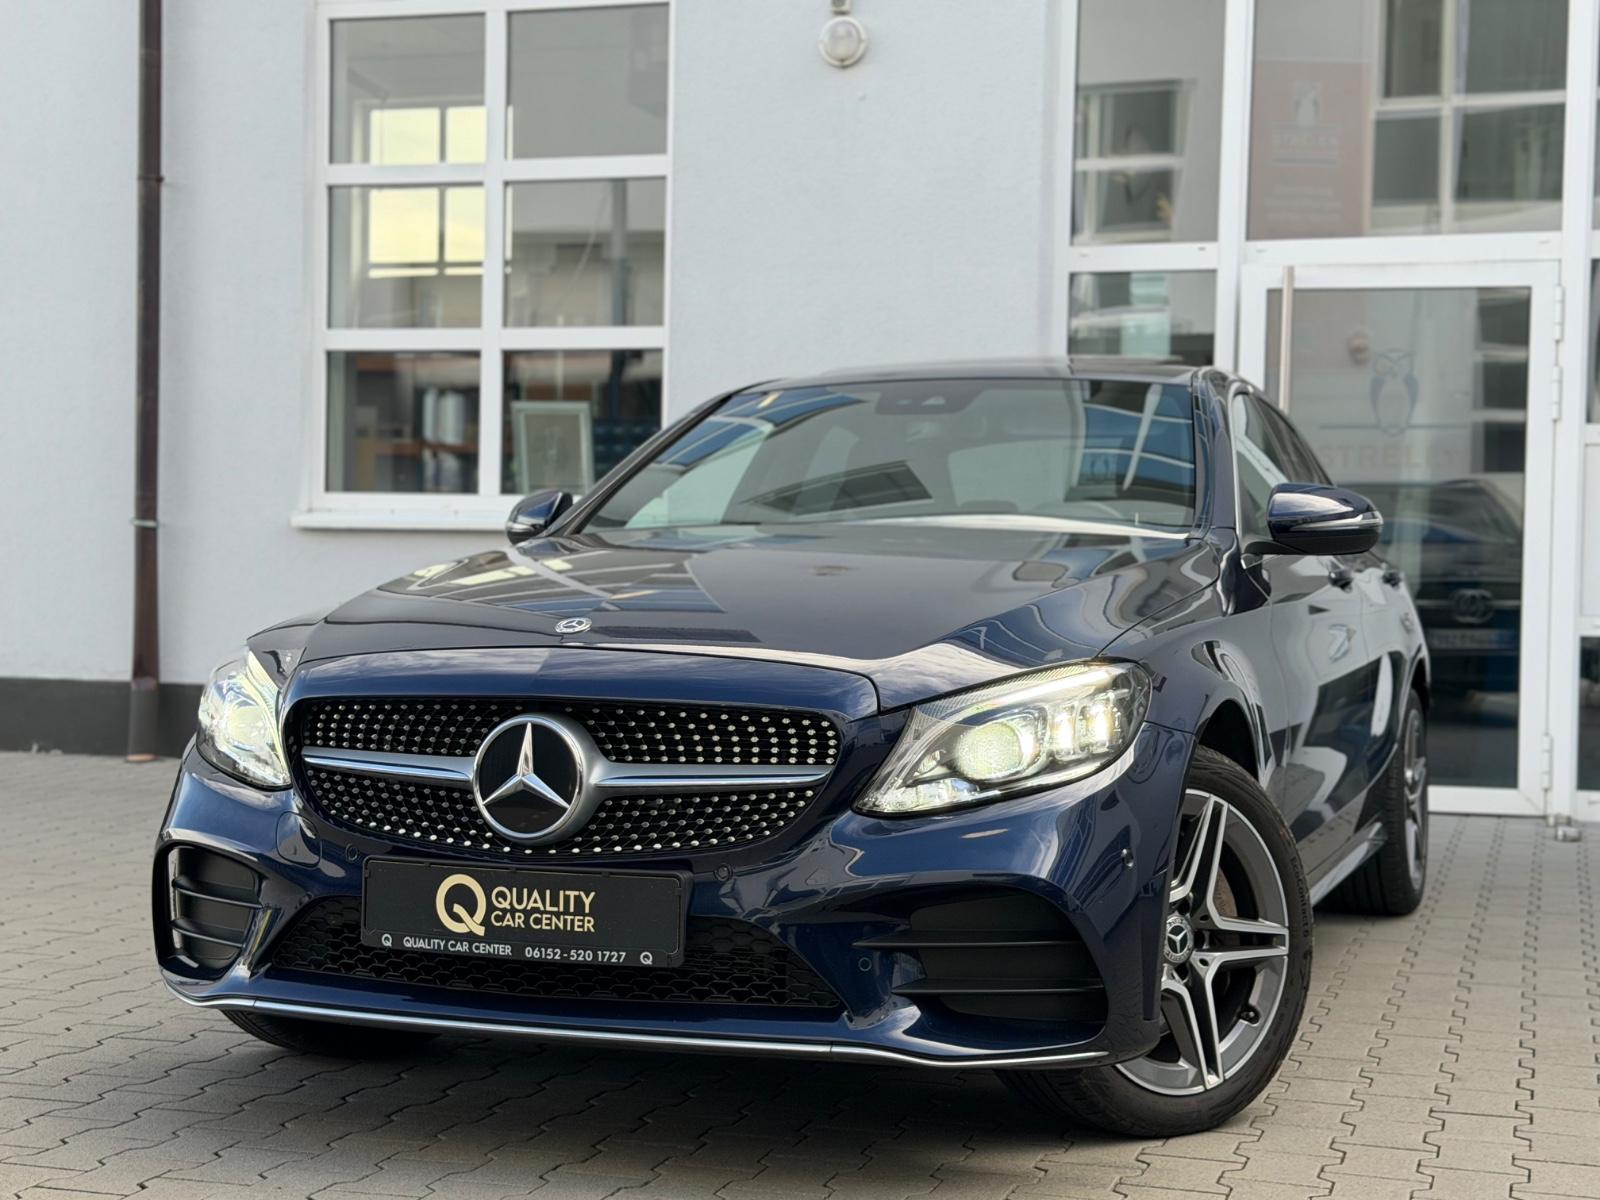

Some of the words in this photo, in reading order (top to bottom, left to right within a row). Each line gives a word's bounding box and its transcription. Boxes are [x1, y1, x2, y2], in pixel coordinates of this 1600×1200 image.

[491, 886, 596, 914] QUALITY
[490, 910, 525, 929] CAR
[529, 913, 595, 933] CENTER
[403, 936, 445, 951] QUALITY
[447, 940, 470, 953] CAR
[472, 942, 512, 956] CENTER
[596, 951, 626, 963] 1727
